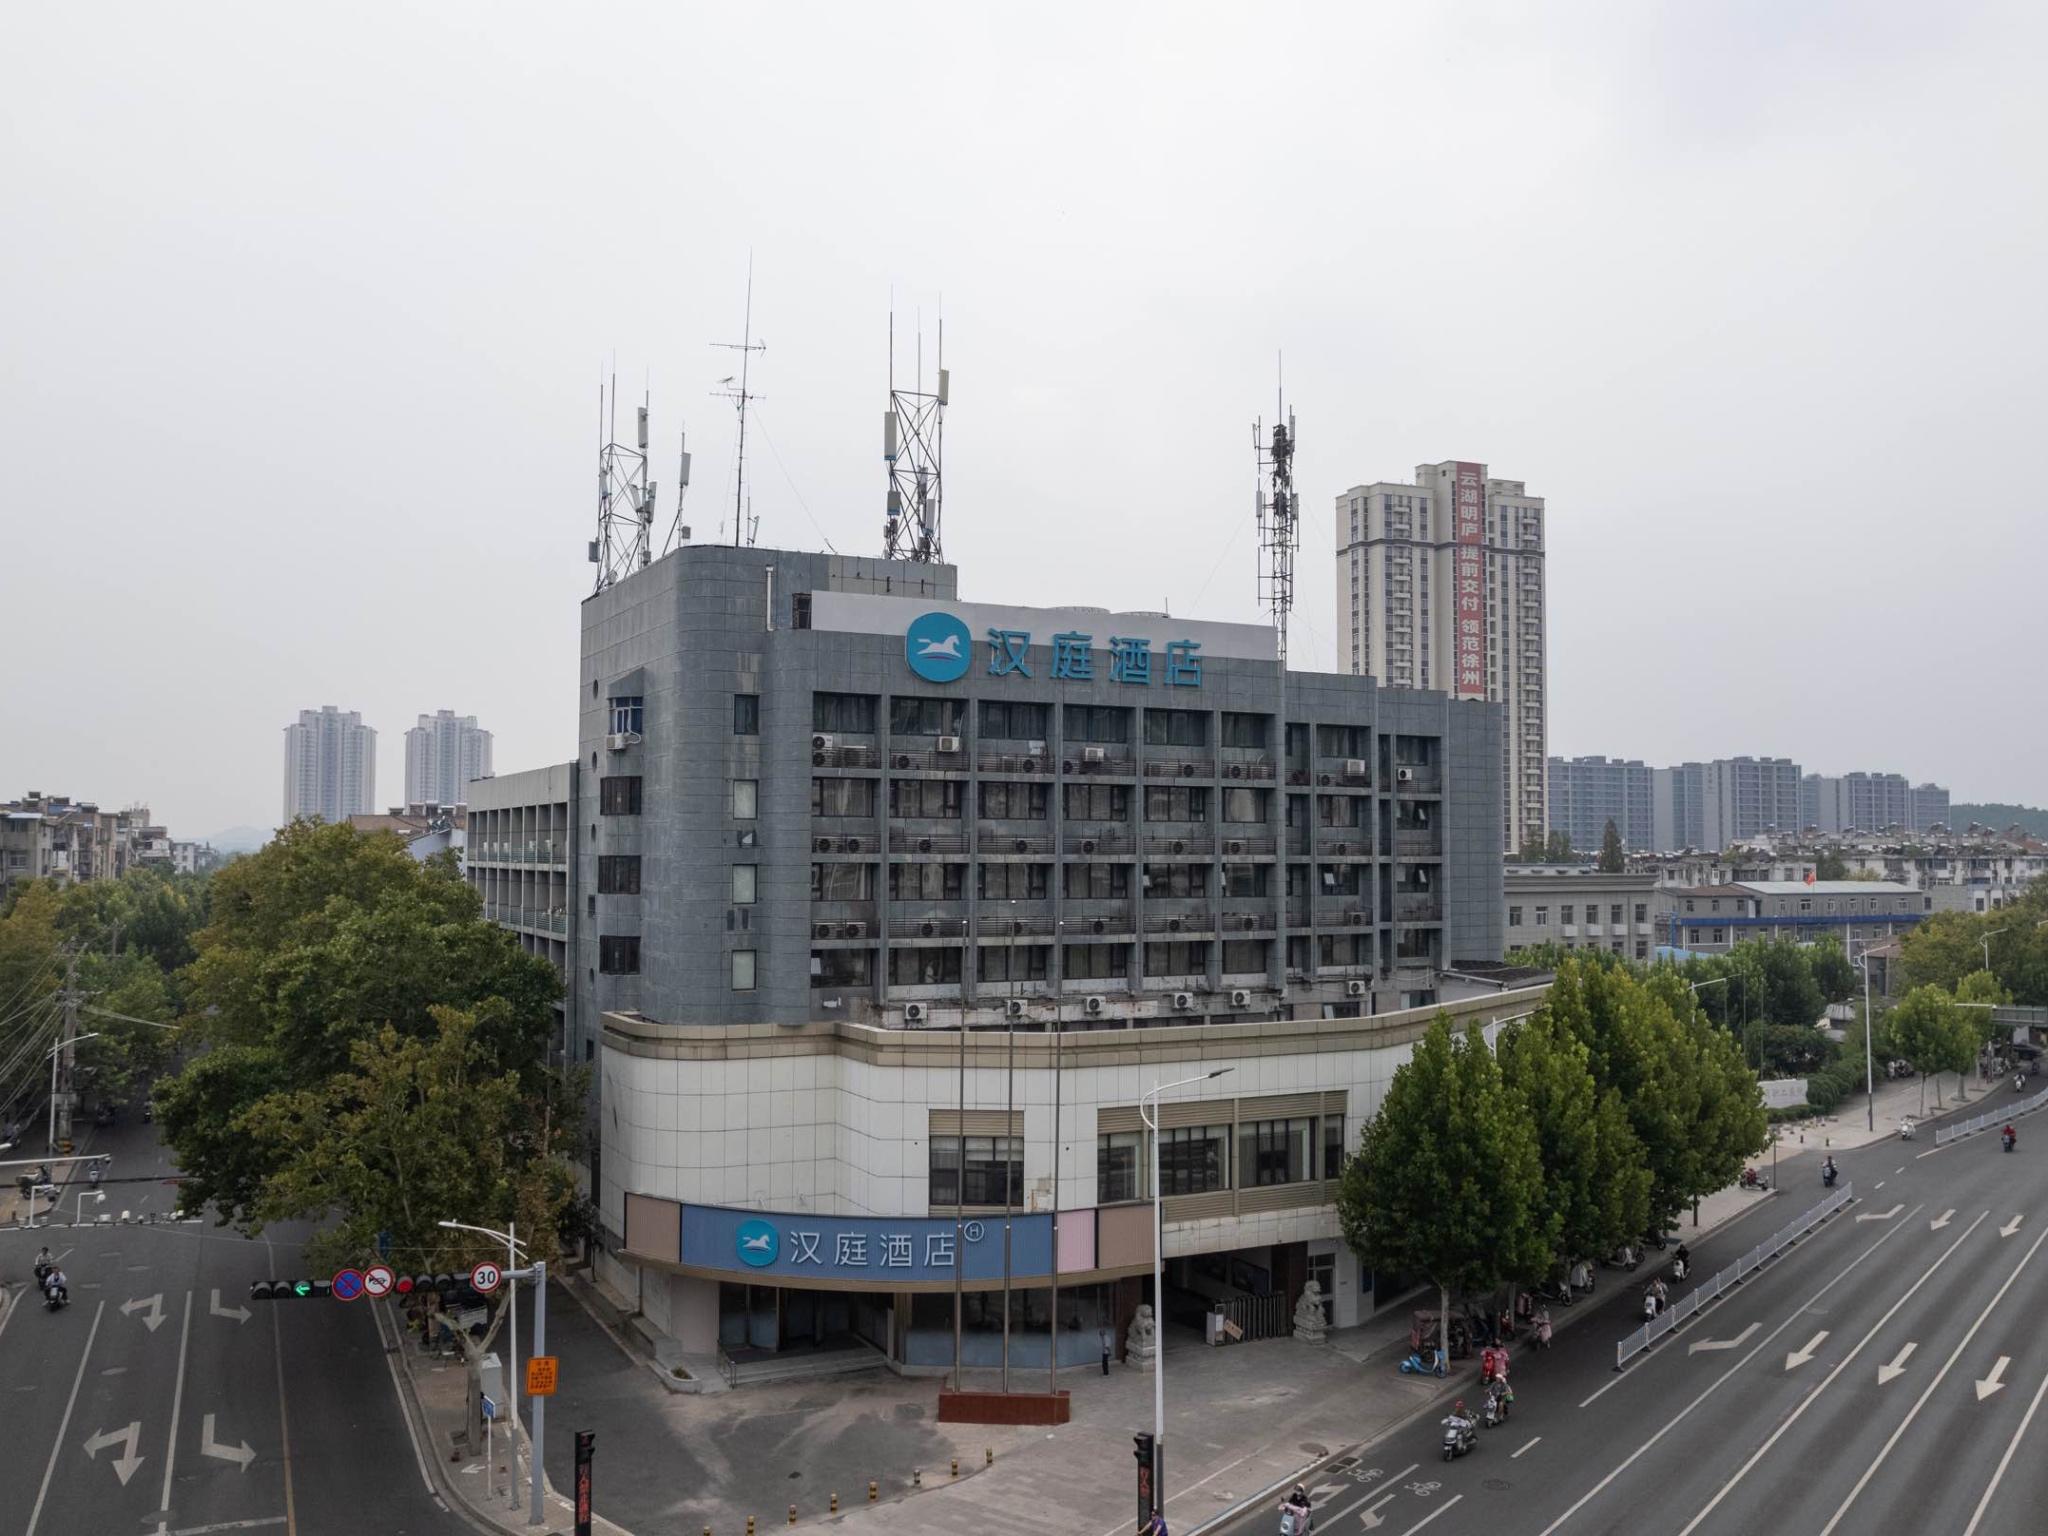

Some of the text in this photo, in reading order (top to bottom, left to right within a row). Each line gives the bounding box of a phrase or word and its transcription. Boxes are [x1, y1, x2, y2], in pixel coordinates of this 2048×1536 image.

[1460, 472, 1479, 685] 云湖明庐 提前交付 领范徐州
[986, 627, 1202, 687] 汉庭酒店
[789, 1230, 956, 1268] 汉庭酒店
[477, 1270, 496, 1285] 30
